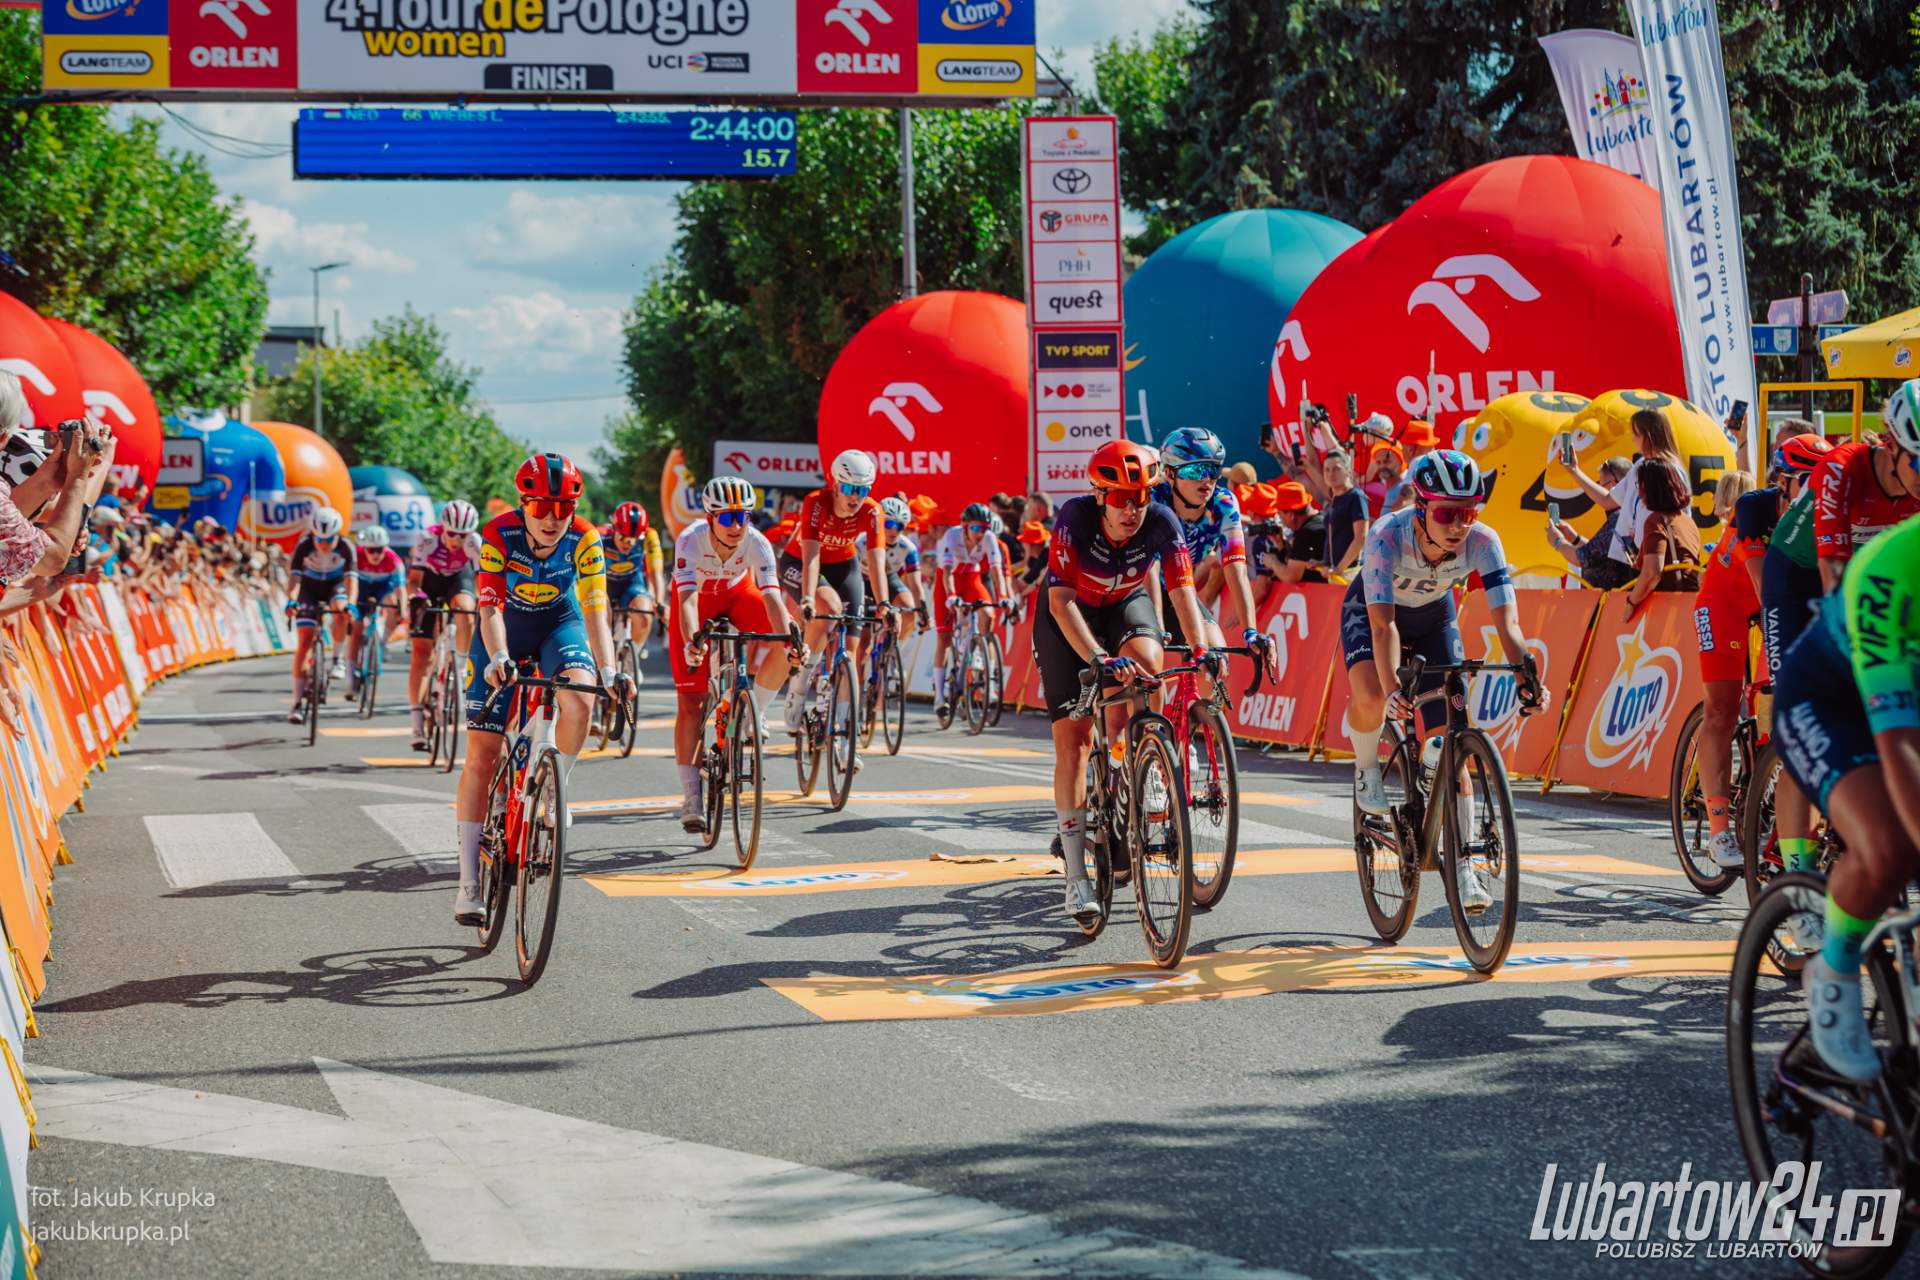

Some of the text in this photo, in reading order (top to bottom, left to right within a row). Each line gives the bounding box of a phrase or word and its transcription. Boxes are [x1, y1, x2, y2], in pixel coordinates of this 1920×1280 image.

[956, 2, 999, 24] LOTTO
[363, 30, 506, 57] women
[67, 57, 147, 68] LANGTEAM
[189, 46, 279, 68] ORLEN
[648, 55, 682, 69] UCI
[815, 52, 900, 74] ORLEN
[511, 66, 587, 91] FINISH
[943, 66, 1017, 76] LANGTEAM
[690, 117, 795, 140] 2:44:00
[742, 148, 791, 167] 15.7
[1065, 214, 1108, 224] GRUPA
[1059, 260, 1091, 272] PHH
[1049, 289, 1104, 314] quest
[1045, 345, 1111, 356] TVP SPORT
[1070, 423, 1112, 438] onet
[757, 457, 819, 472] ORLEN
[262, 501, 313, 524] LOTTO
[1858, 575, 1895, 669] VIFRA
[1768, 608, 1781, 671] VAIANO
[1239, 693, 1296, 732] ORLEN
[1606, 676, 1663, 737] LOTTO
[967, 978, 1137, 1001] LOTTO
